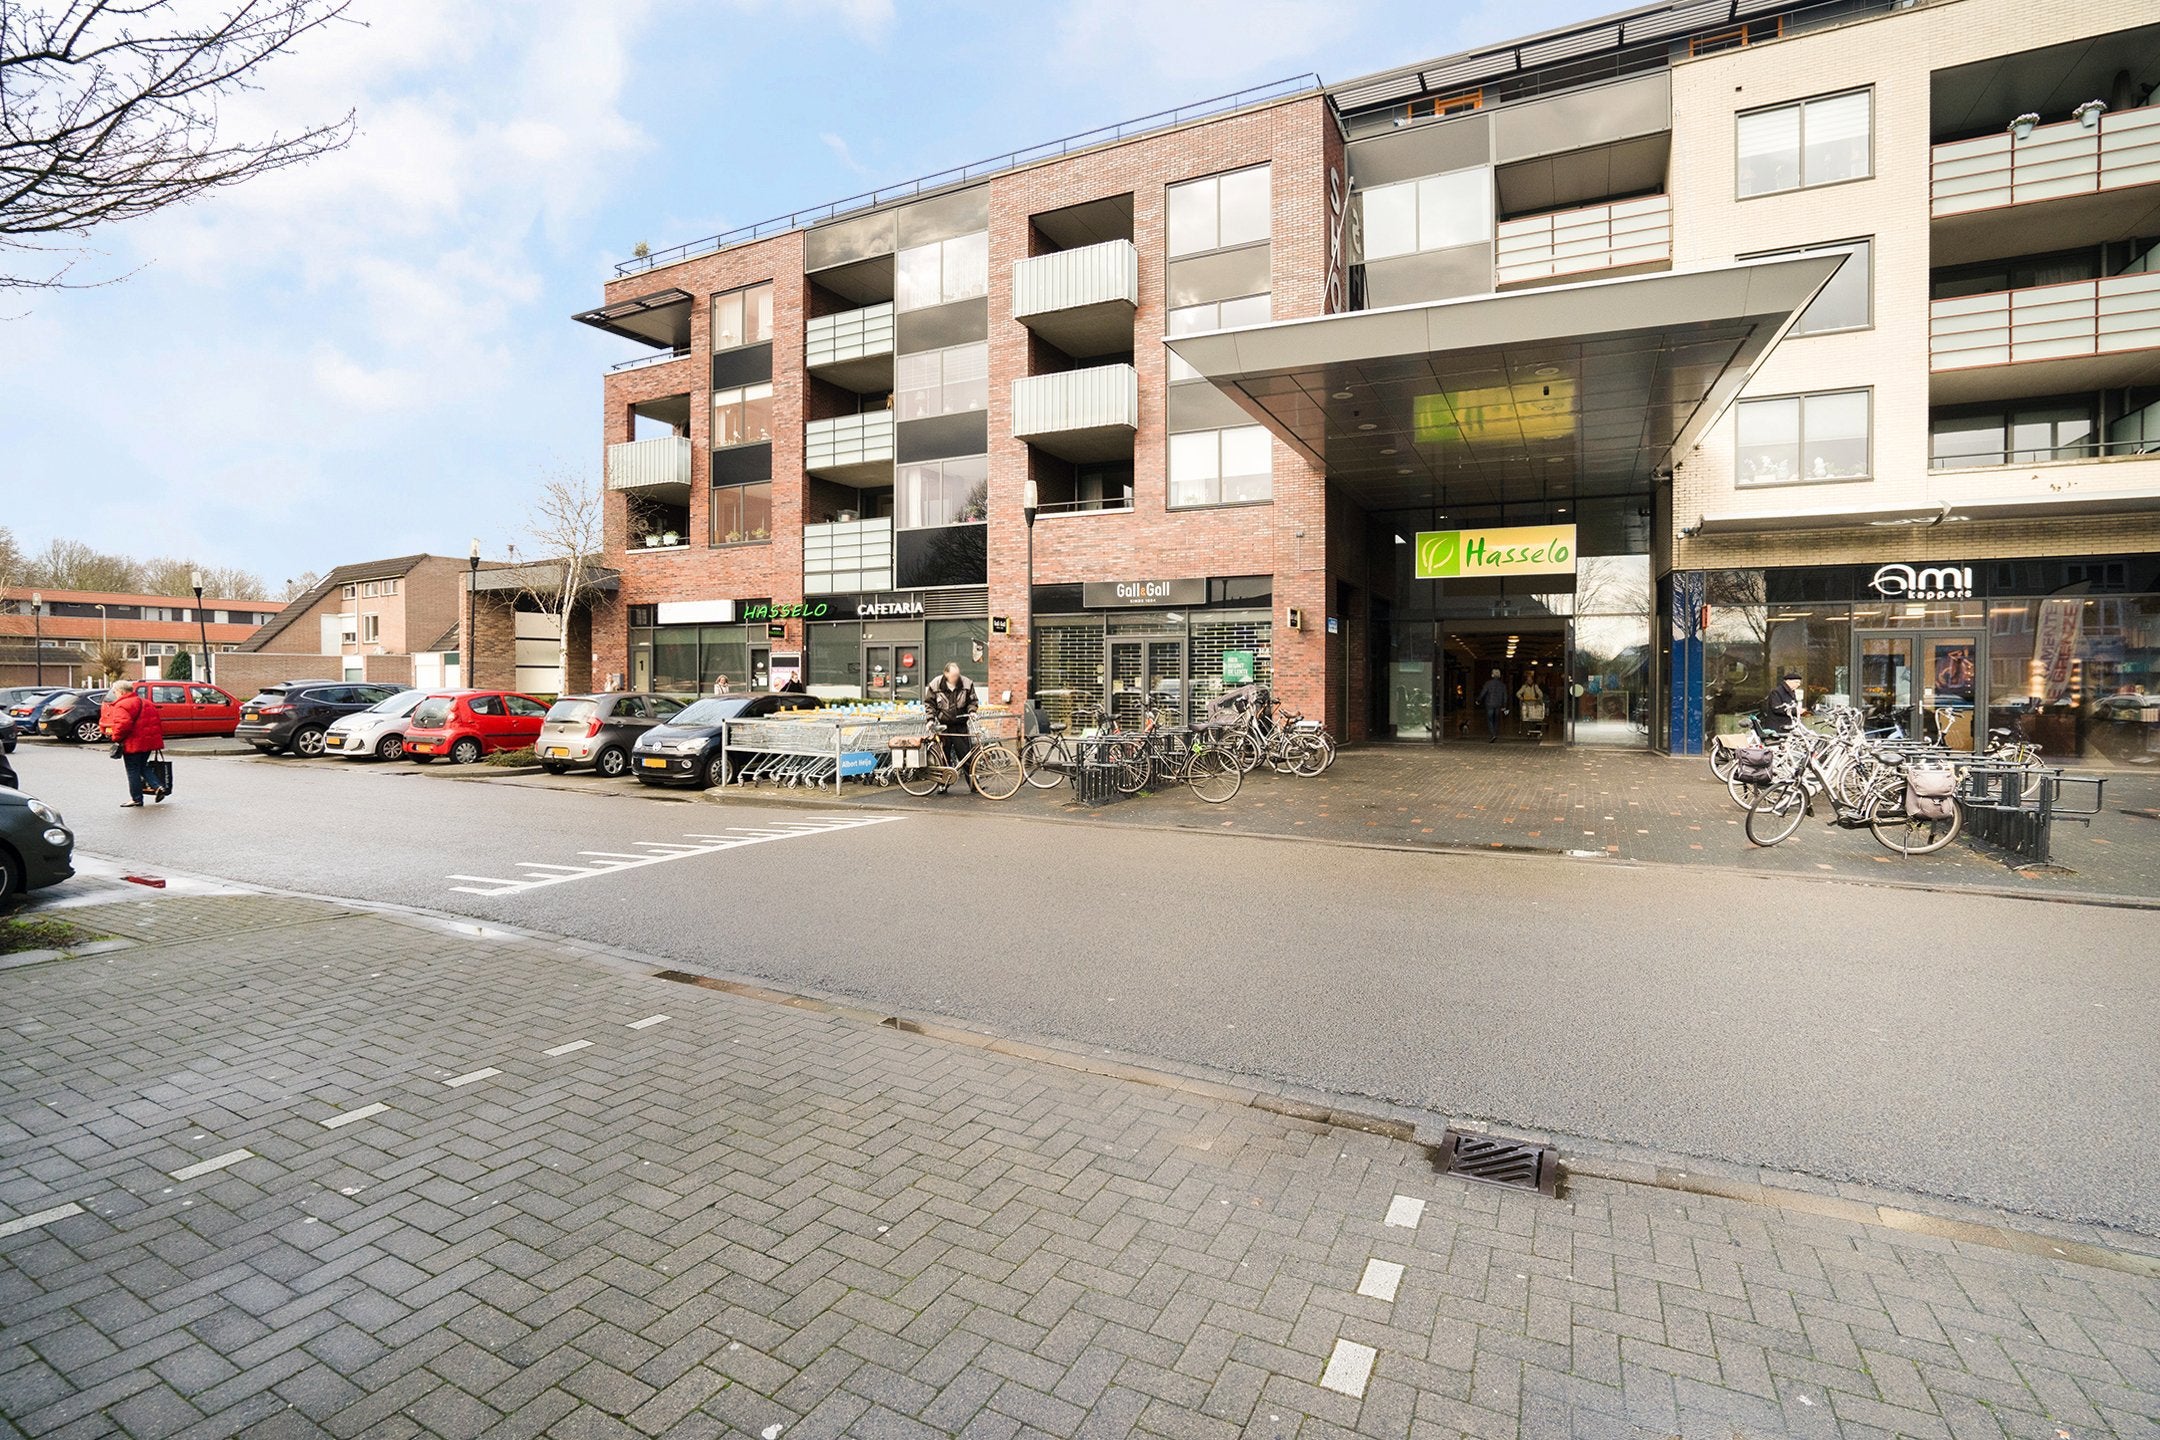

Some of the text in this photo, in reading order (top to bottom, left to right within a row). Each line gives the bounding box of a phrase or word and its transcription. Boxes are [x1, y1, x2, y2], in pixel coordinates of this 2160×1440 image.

[1466, 537, 1569, 567] Hasselo
[1116, 581, 1170, 598] Gall&Gall
[1907, 590, 1973, 600] kappers
[743, 603, 828, 619] HASSELO
[857, 602, 924, 615] CAFETARIA
[842, 760, 858, 768] Albert
